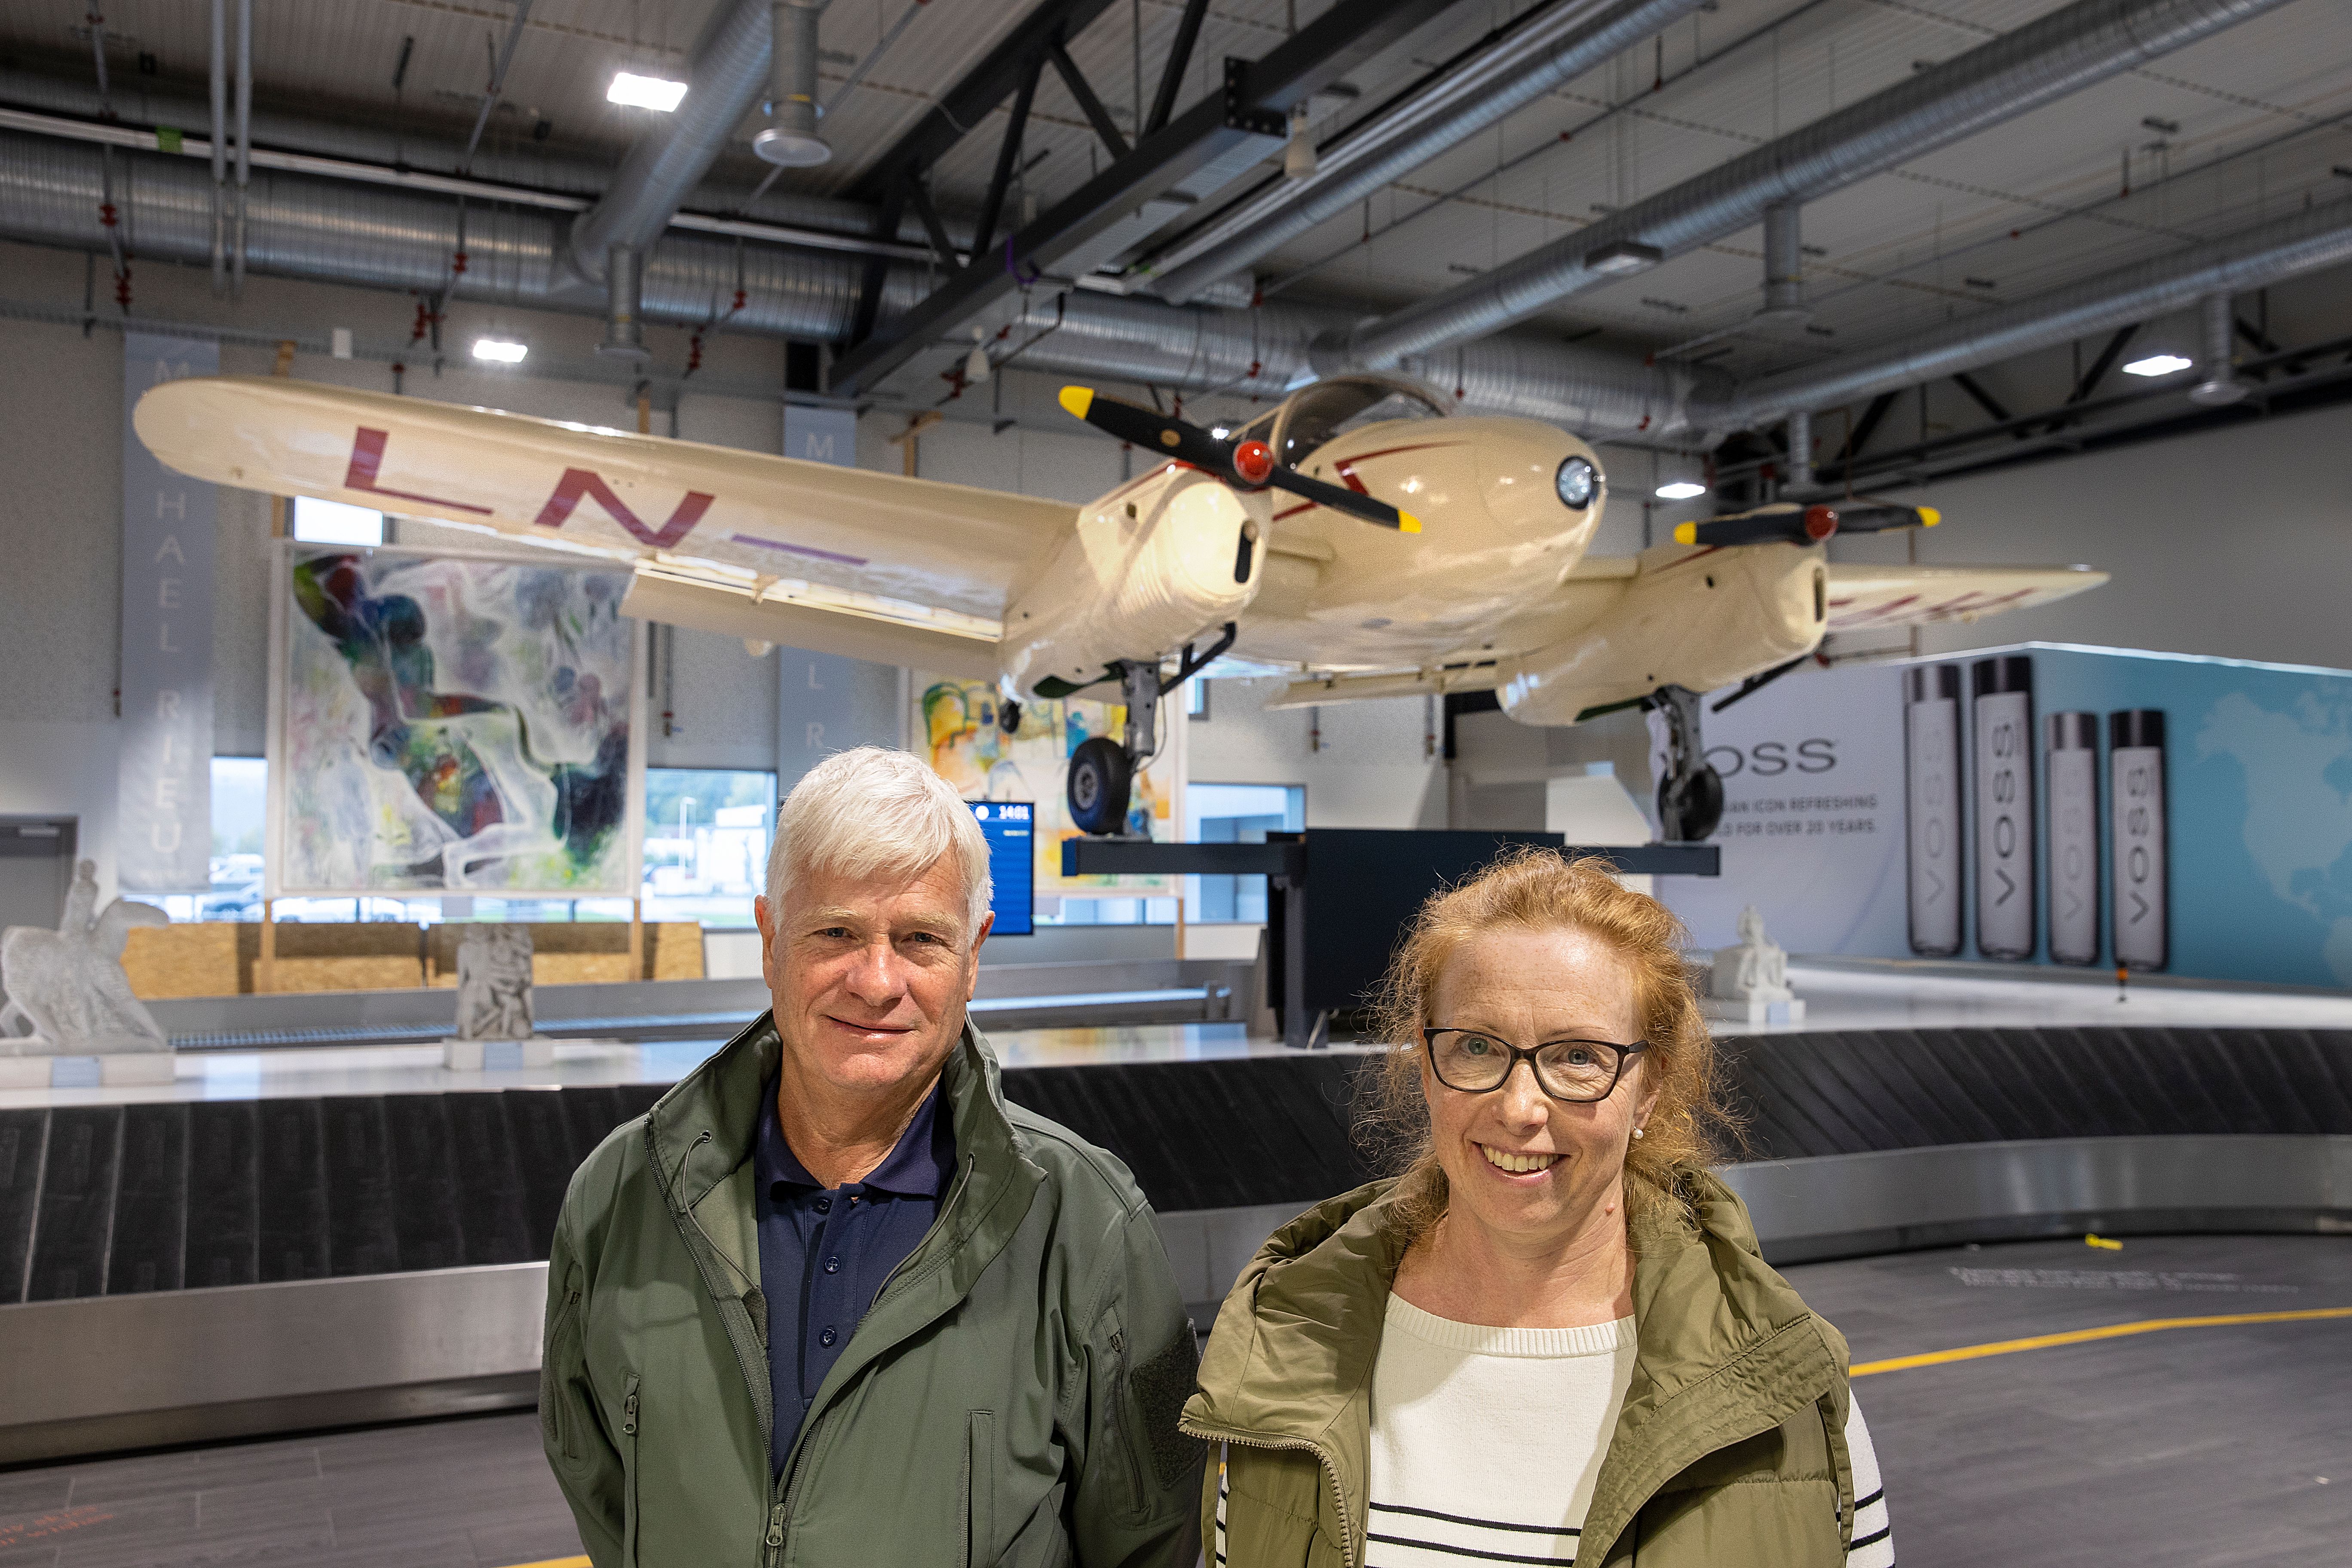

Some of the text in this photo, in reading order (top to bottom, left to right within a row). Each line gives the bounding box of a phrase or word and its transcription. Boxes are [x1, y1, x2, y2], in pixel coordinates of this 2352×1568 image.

[153, 359, 190, 653] MHAEL
[1661, 738, 1838, 778] OSS
[1788, 794, 1877, 812] REFRESHING
[1992, 723, 2017, 906] VOSS
[1765, 820, 1803, 836] OVER
